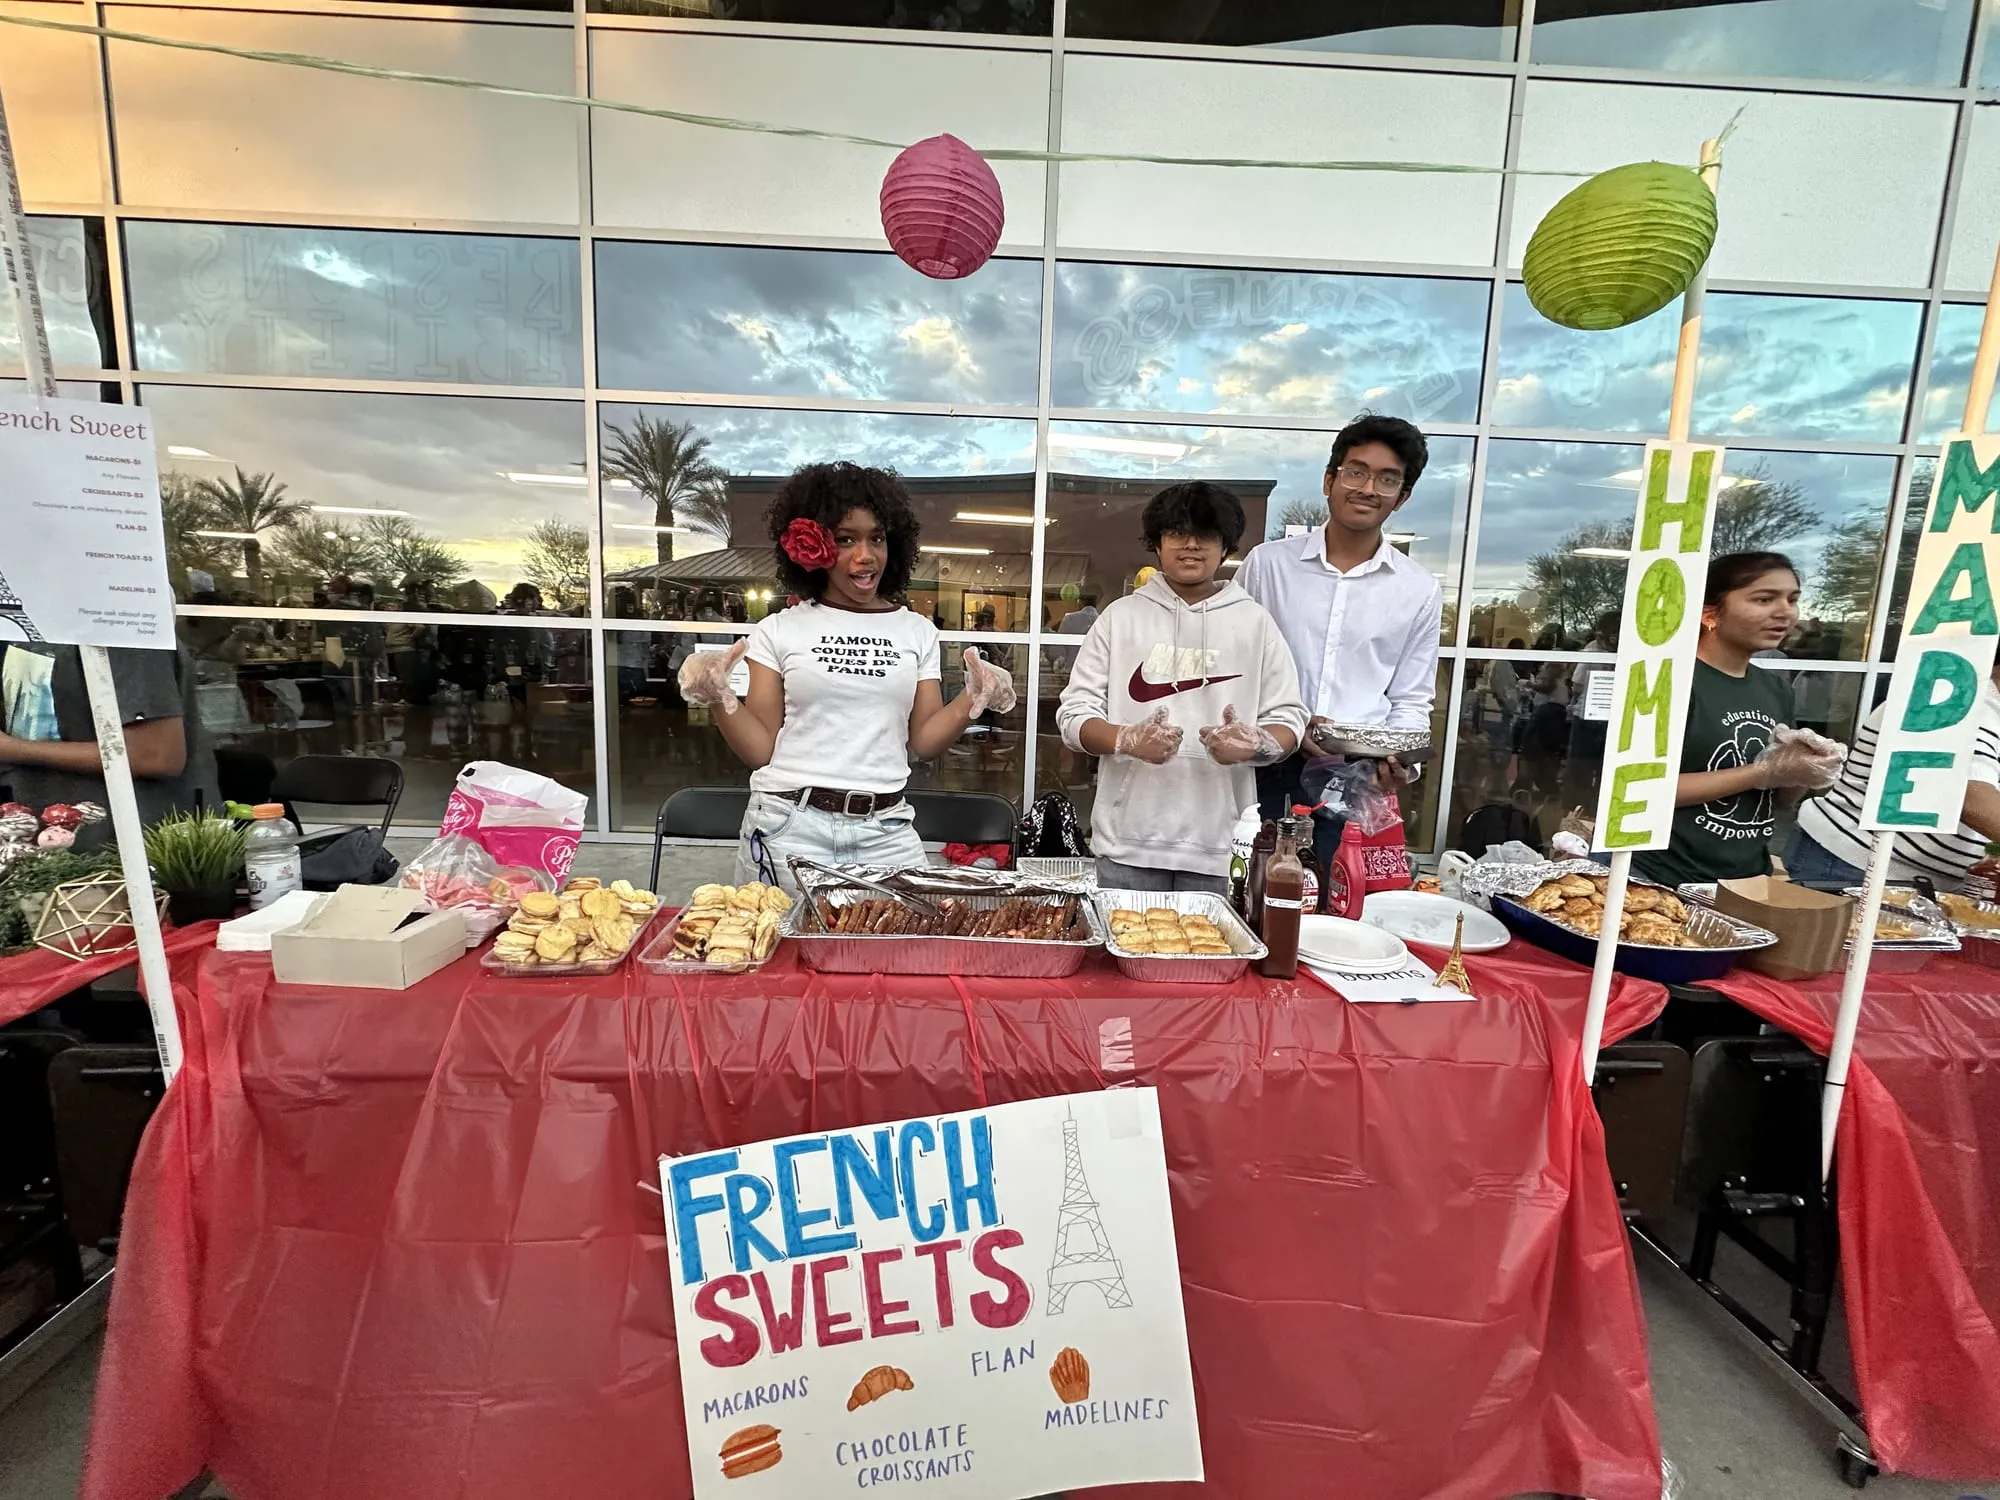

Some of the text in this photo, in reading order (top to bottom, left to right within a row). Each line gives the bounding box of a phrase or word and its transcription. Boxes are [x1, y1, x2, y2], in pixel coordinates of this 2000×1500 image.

[70, 414, 147, 440] Sweet
[85, 551, 115, 559] FRENCH
[78, 607, 102, 615] Please
[820, 636, 892, 648] L'AMOUR
[1604, 449, 1716, 848] HOME
[1877, 440, 2000, 827] MADE
[811, 647, 901, 660] COURT LES
[817, 656, 897, 667] RUES DE
[826, 665, 886, 678] PARIS
[1722, 709, 1776, 727] education
[669, 1115, 1001, 1286] FRENCH
[693, 1228, 1032, 1368] SWEETS
[972, 1339, 1036, 1377] FLAN
[702, 1375, 809, 1423] MACARONS
[1044, 1398, 1170, 1430] MADELINES
[835, 1423, 968, 1467] CHOCOLATE
[857, 1450, 975, 1489] CROISSANTS
